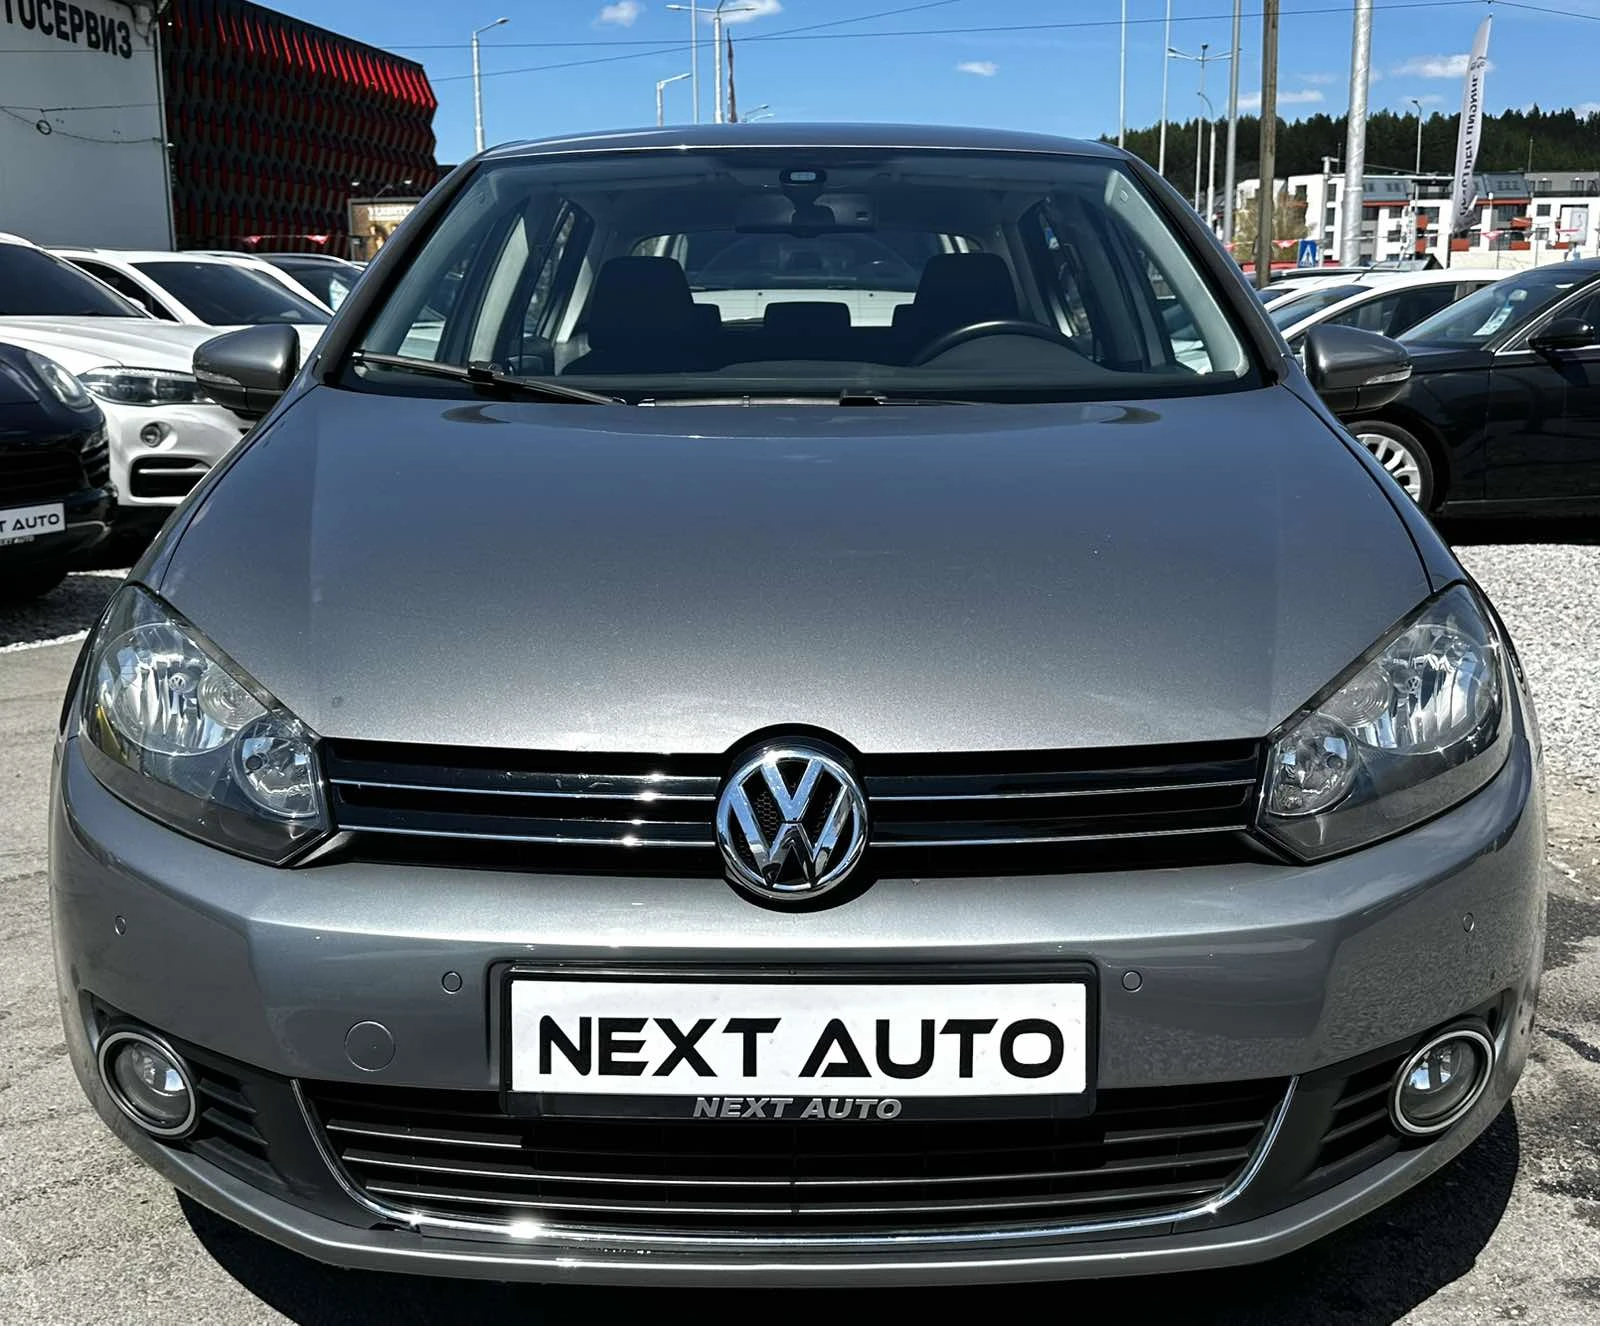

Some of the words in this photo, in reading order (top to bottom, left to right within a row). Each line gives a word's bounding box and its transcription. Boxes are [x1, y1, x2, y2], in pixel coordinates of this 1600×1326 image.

[12, 513, 60, 531] AUTO
[721, 751, 862, 895] VW
[539, 1015, 782, 1077] NEXT
[798, 1018, 1064, 1079] AUTO
[693, 1097, 794, 1118] NEXT
[800, 1098, 902, 1119] AUTO
